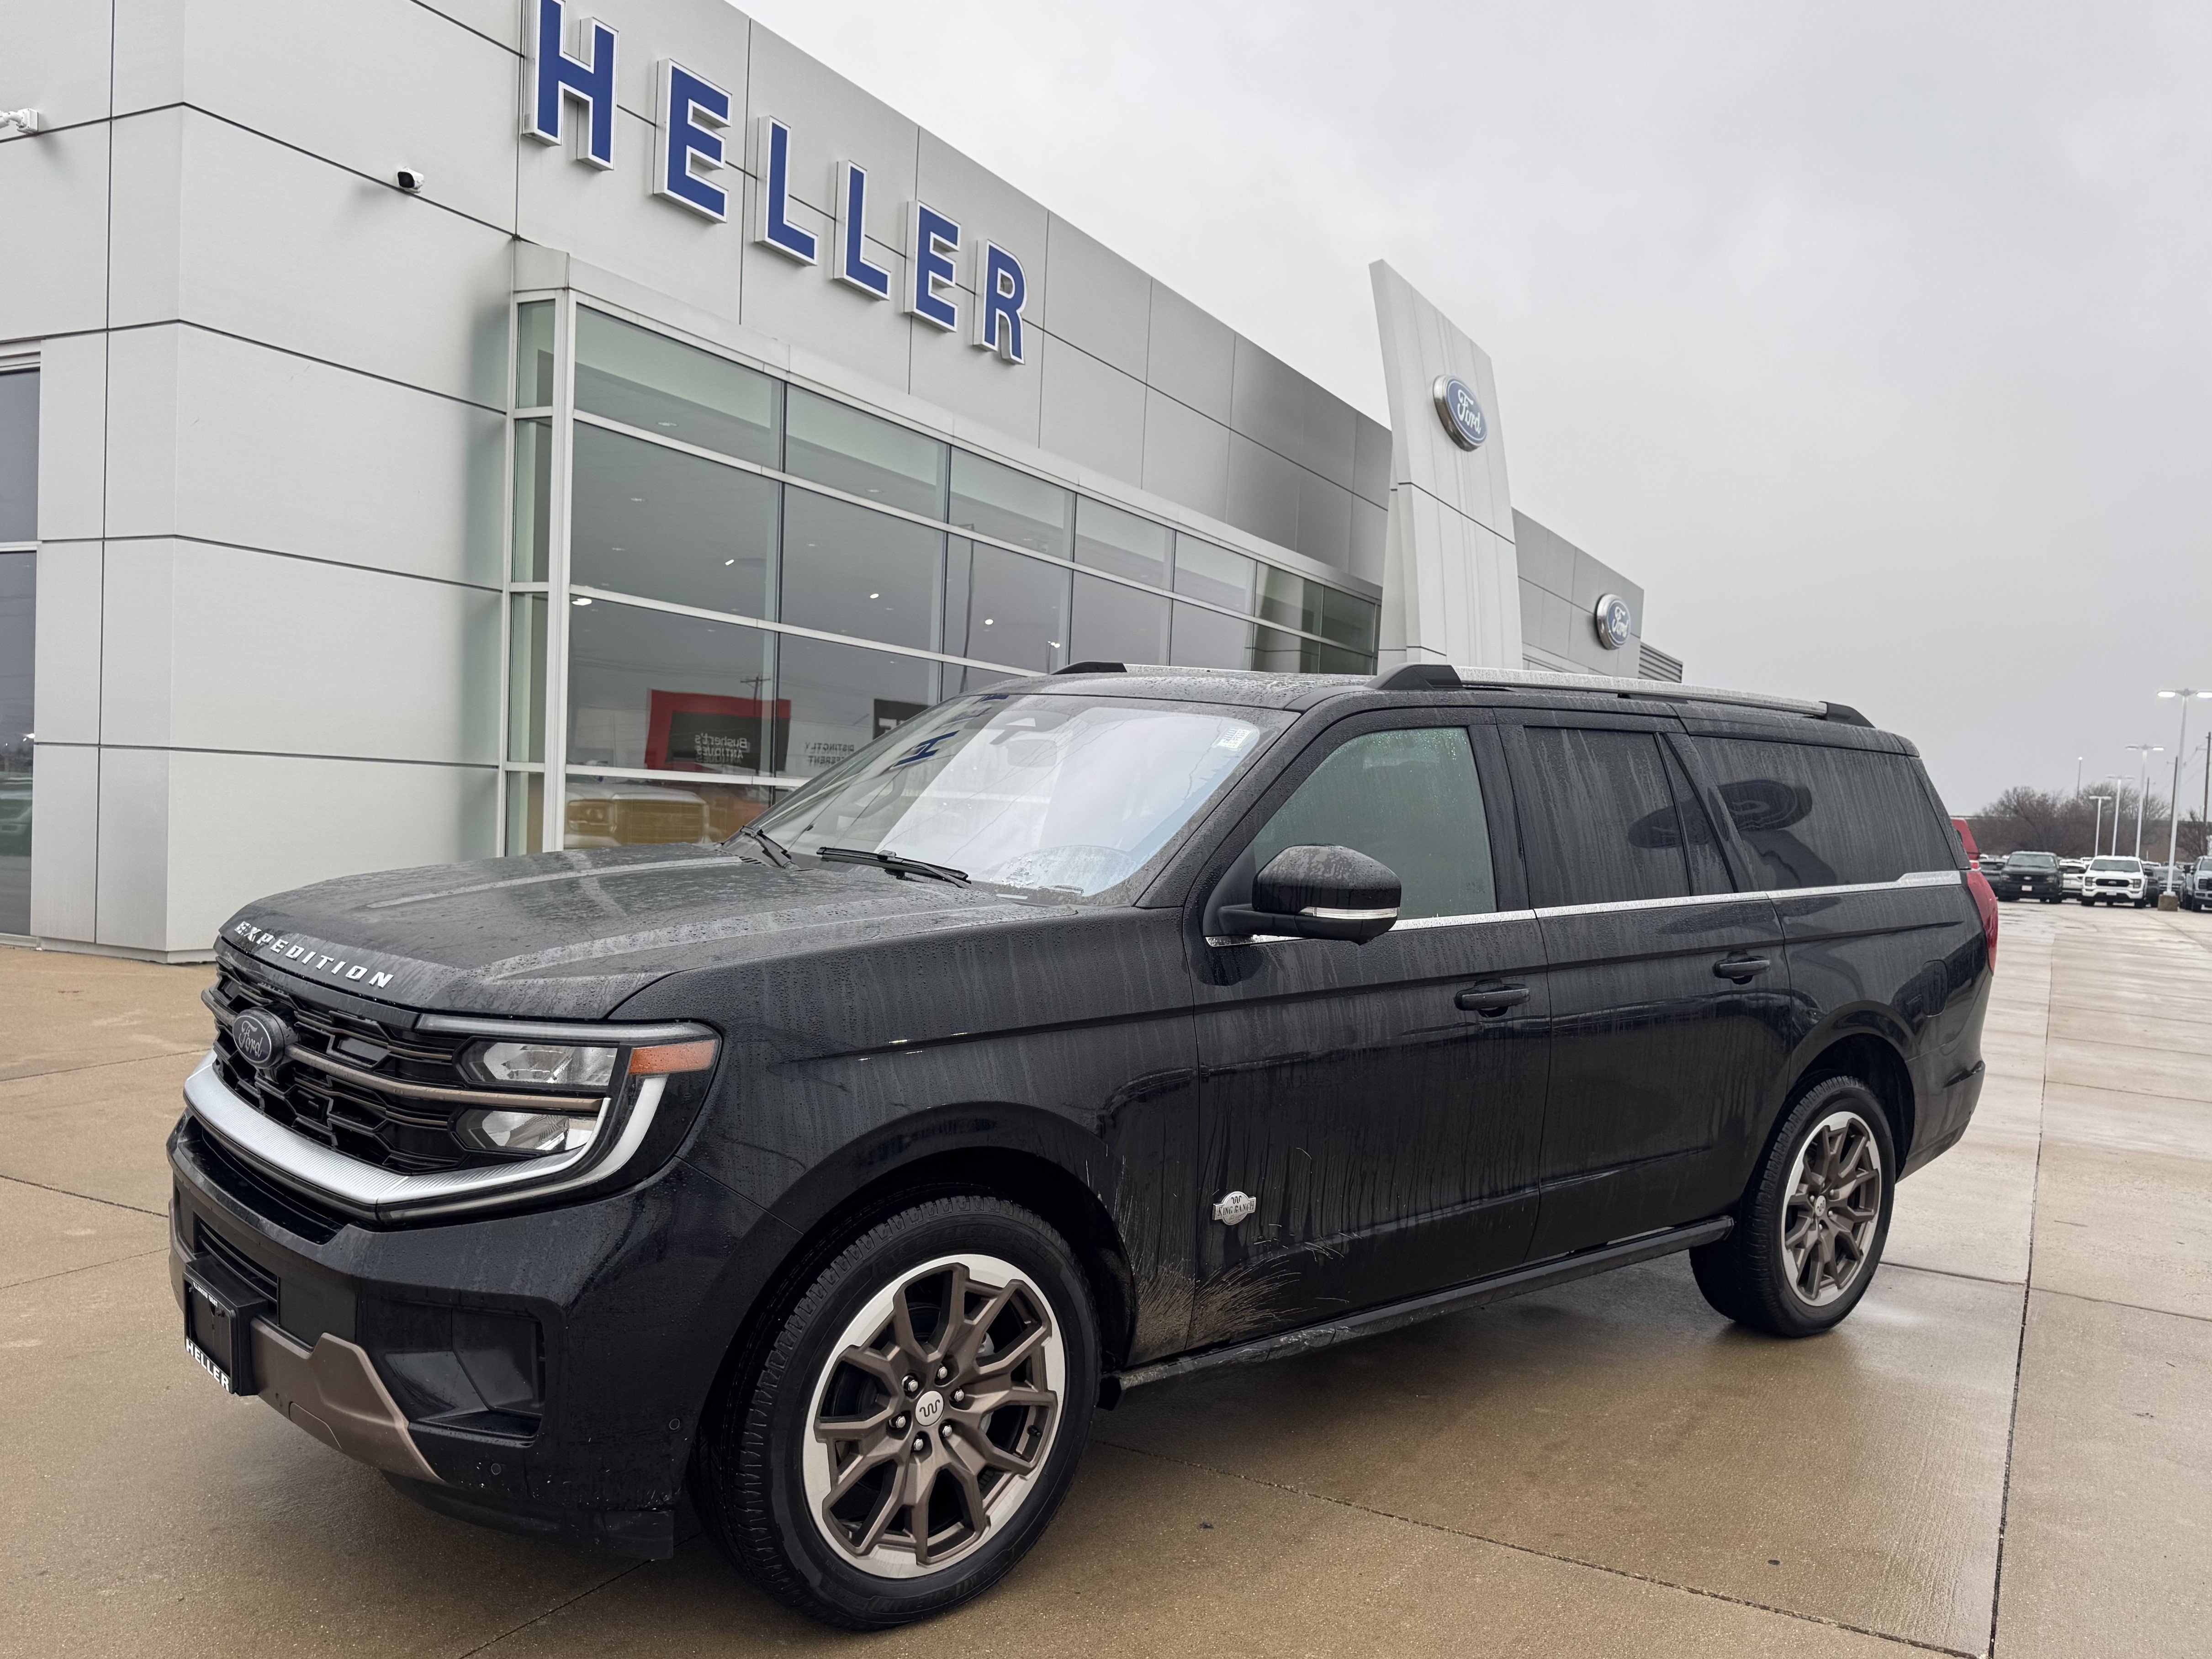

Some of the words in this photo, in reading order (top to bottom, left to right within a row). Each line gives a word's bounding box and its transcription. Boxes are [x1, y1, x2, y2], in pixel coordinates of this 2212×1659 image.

[523, 0, 1027, 366] HELLER
[1457, 389, 1482, 435] Ford
[1612, 606, 1629, 638] Ford
[233, 921, 395, 988] EXPEDITION
[238, 1020, 264, 1058] Ford
[1217, 1206, 1233, 1217] KING
[1234, 1201, 1254, 1214] RANCH
[185, 1338, 229, 1392] HELLER
